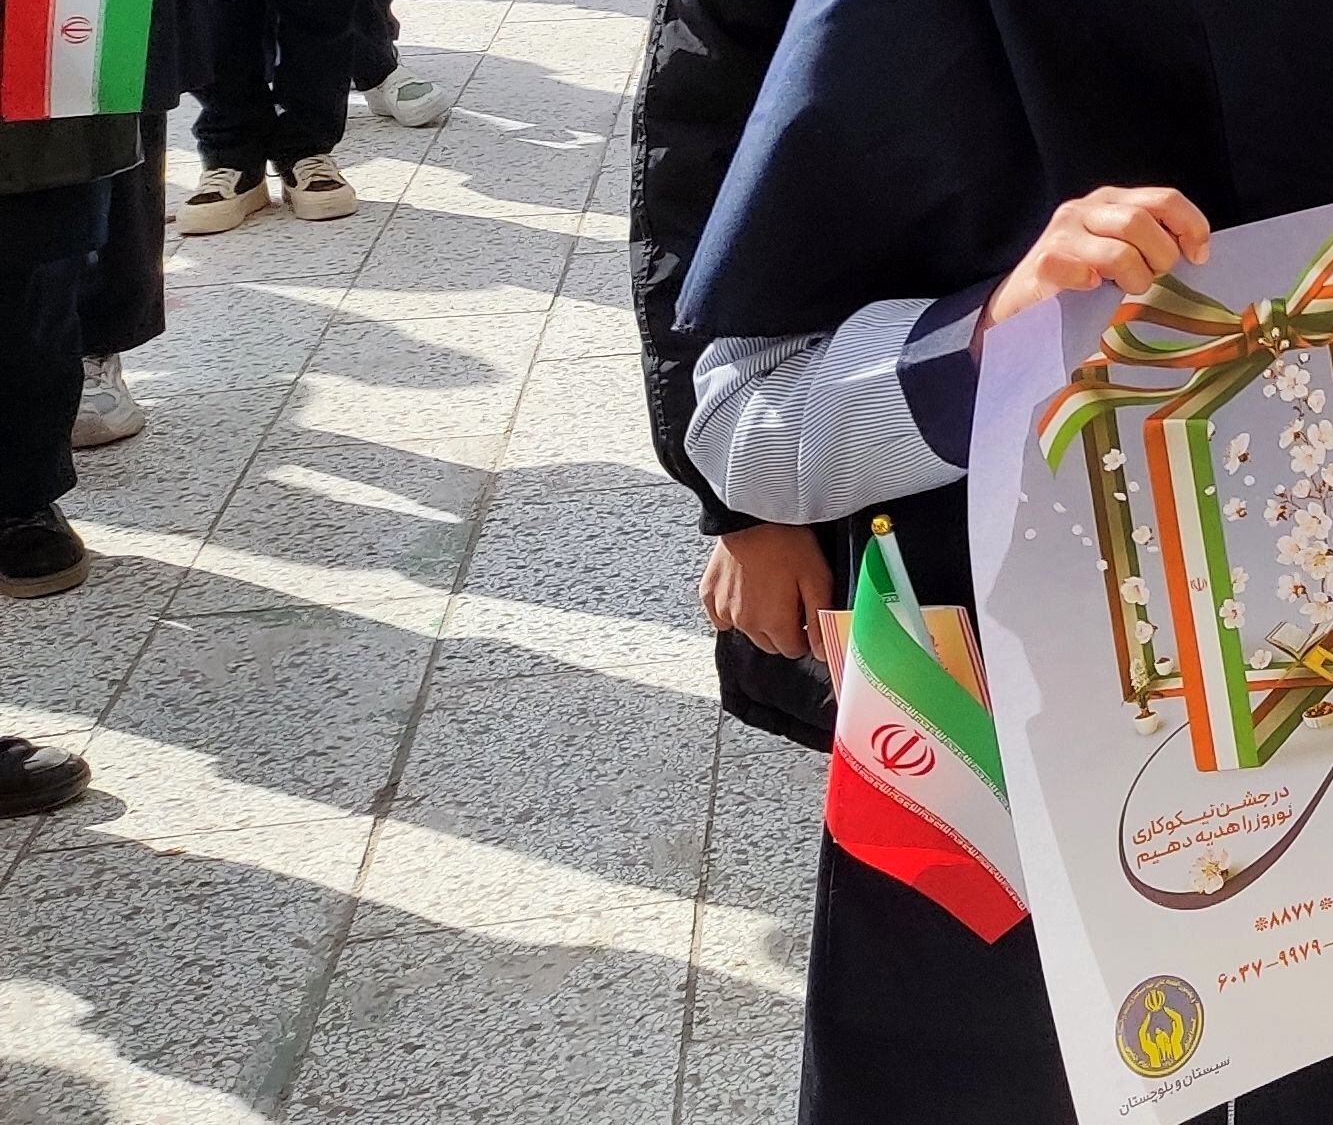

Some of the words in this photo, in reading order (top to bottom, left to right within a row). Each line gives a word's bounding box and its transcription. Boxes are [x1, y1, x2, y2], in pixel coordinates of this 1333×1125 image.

[1216, 790, 1271, 818] جشن
[1271, 786, 1290, 806] در
[1132, 804, 1215, 846] نیکوکاری
[1241, 815, 1252, 834] را
[1253, 802, 1293, 832] نوروز
[1195, 821, 1241, 847] هدیه
[1136, 836, 1192, 870] دهیم
[1175, 1079, 1183, 1091] و
[1182, 1056, 1231, 1087] سیستان
[1118, 1081, 1175, 1117] بلوچستان
